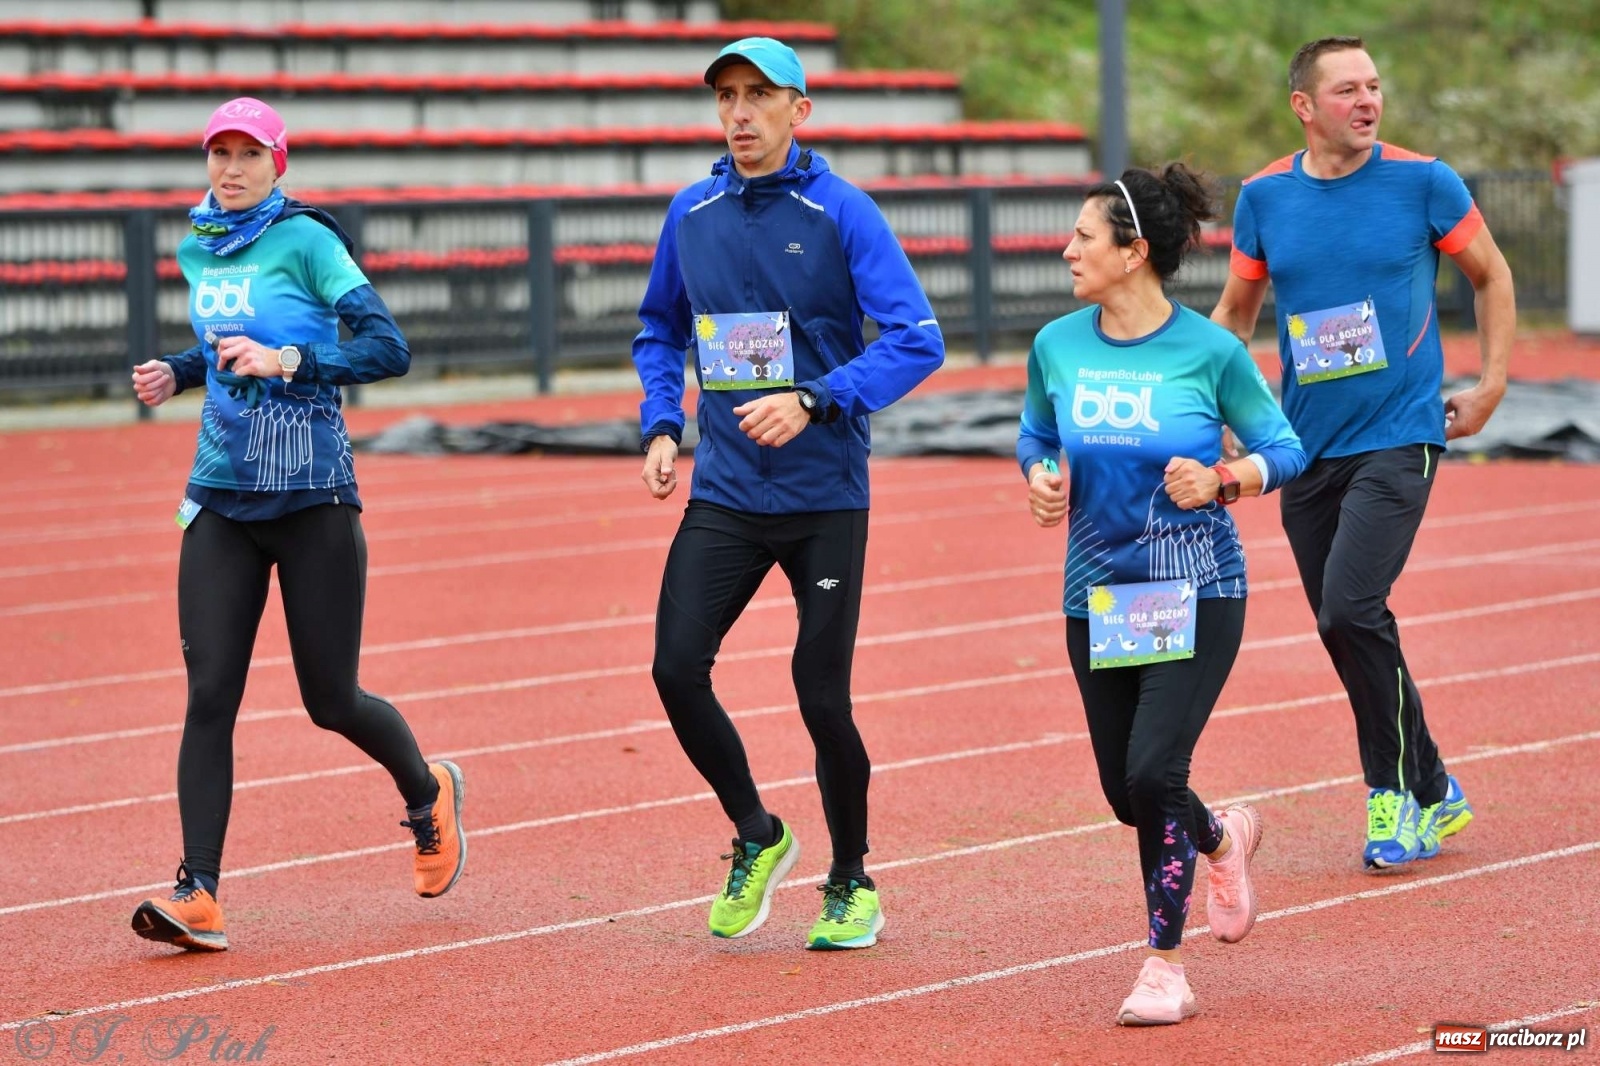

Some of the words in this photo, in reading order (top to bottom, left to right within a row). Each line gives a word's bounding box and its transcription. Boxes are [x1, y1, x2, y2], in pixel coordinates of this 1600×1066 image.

[202, 263, 259, 277] BiegamBoLubie
[195, 277, 256, 318] bbl
[204, 322, 246, 333] RACIBÓRZ
[708, 341, 725, 351] BIEG
[728, 341, 744, 350] DLA
[1300, 337, 1317, 348] BIEG
[1319, 334, 1335, 345] DLA
[1343, 347, 1376, 367] 269
[751, 363, 784, 380] 039
[1077, 367, 1164, 383] BiegamBoLubie
[1071, 383, 1160, 432] bbl
[1082, 433, 1142, 447] RACIBÓRZ
[816, 577, 840, 590] 4F
[1103, 614, 1125, 626] BIEG
[1129, 612, 1148, 623] DLA
[1153, 633, 1186, 652] 014
